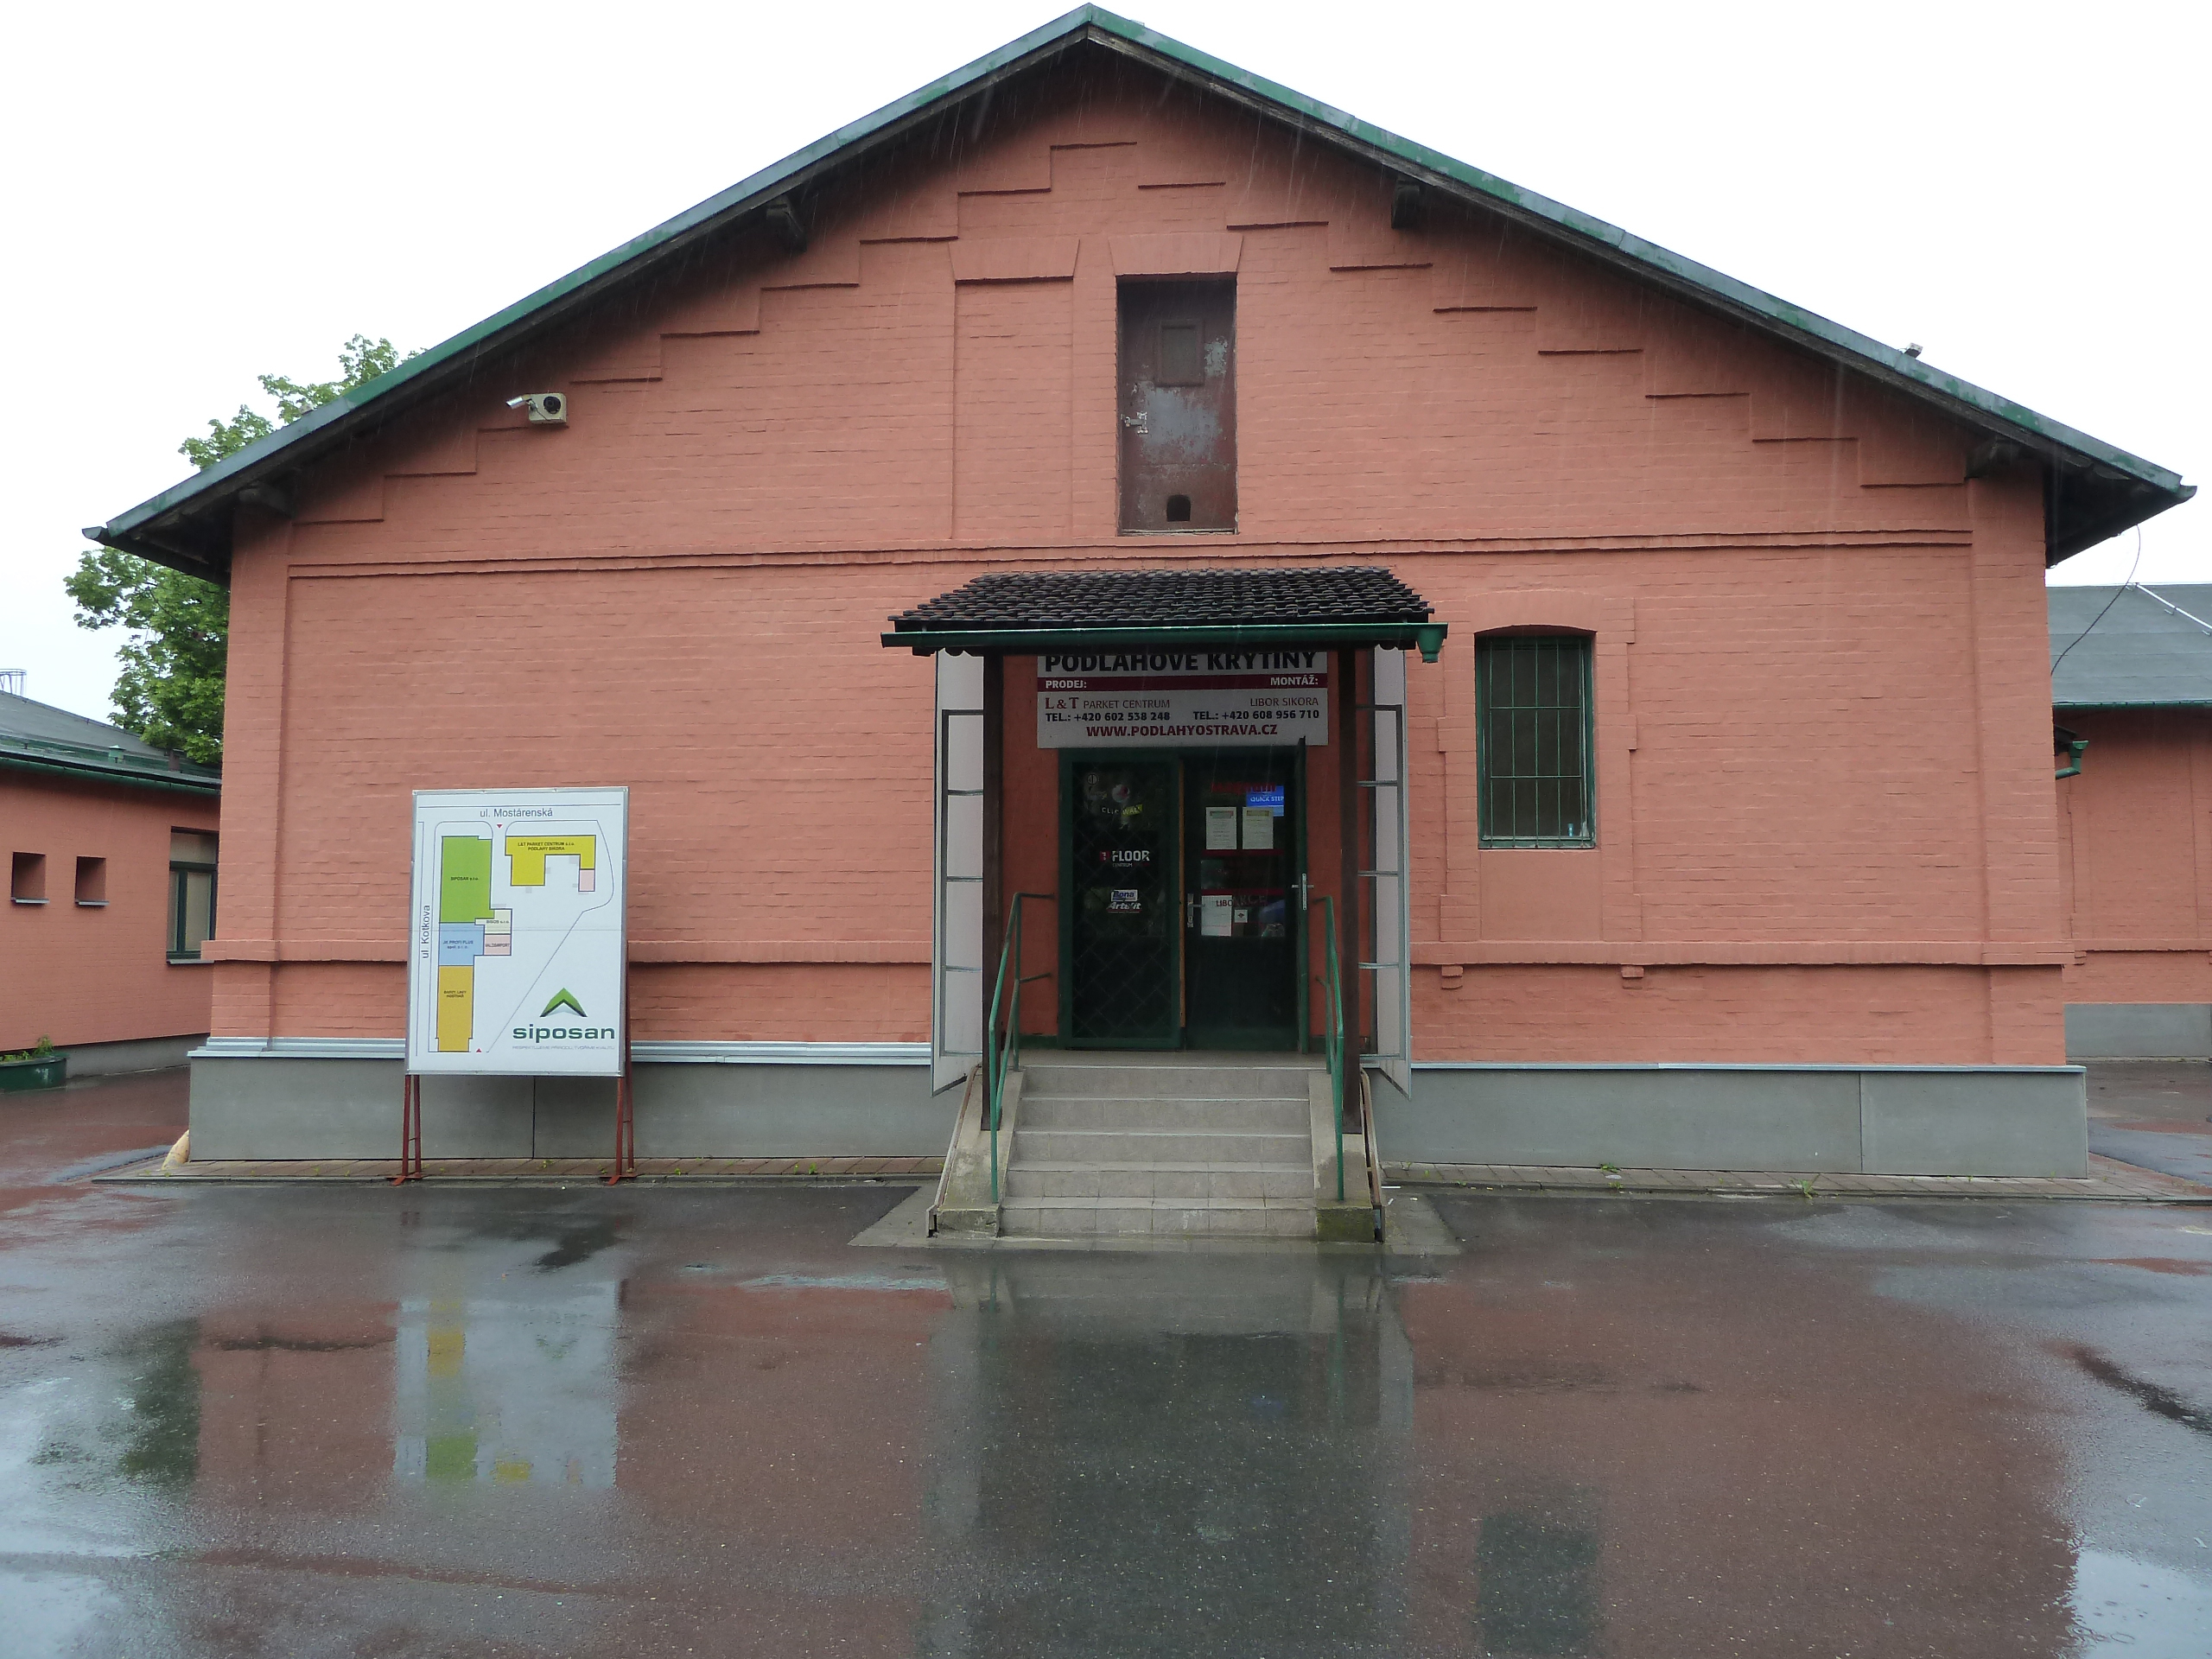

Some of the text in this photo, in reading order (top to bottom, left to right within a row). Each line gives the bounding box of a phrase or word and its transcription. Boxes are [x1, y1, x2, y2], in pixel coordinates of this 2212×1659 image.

[1207, 652, 1316, 671] KRYTINY
[1046, 679, 1087, 689] PRODEJ:
[1270, 674, 1319, 686] MONTÁŽ:
[1084, 700, 1119, 709] PARKET
[1122, 699, 1170, 709] CENTRUM
[1250, 697, 1319, 707] LIBOR SIKORA
[1046, 711, 1170, 721] TEL.: +420 602 538 248
[1193, 709, 1319, 721] TEL.: +420 608 956 710
[1086, 724, 1278, 737] WWW.PODLAHYOSTRAVA.CZ
[480, 808, 553, 817] ul. Mostárenská
[1112, 850, 1150, 861] FLOOR
[421, 905, 430, 944] Kotkova
[512, 1023, 615, 1044] siposan
